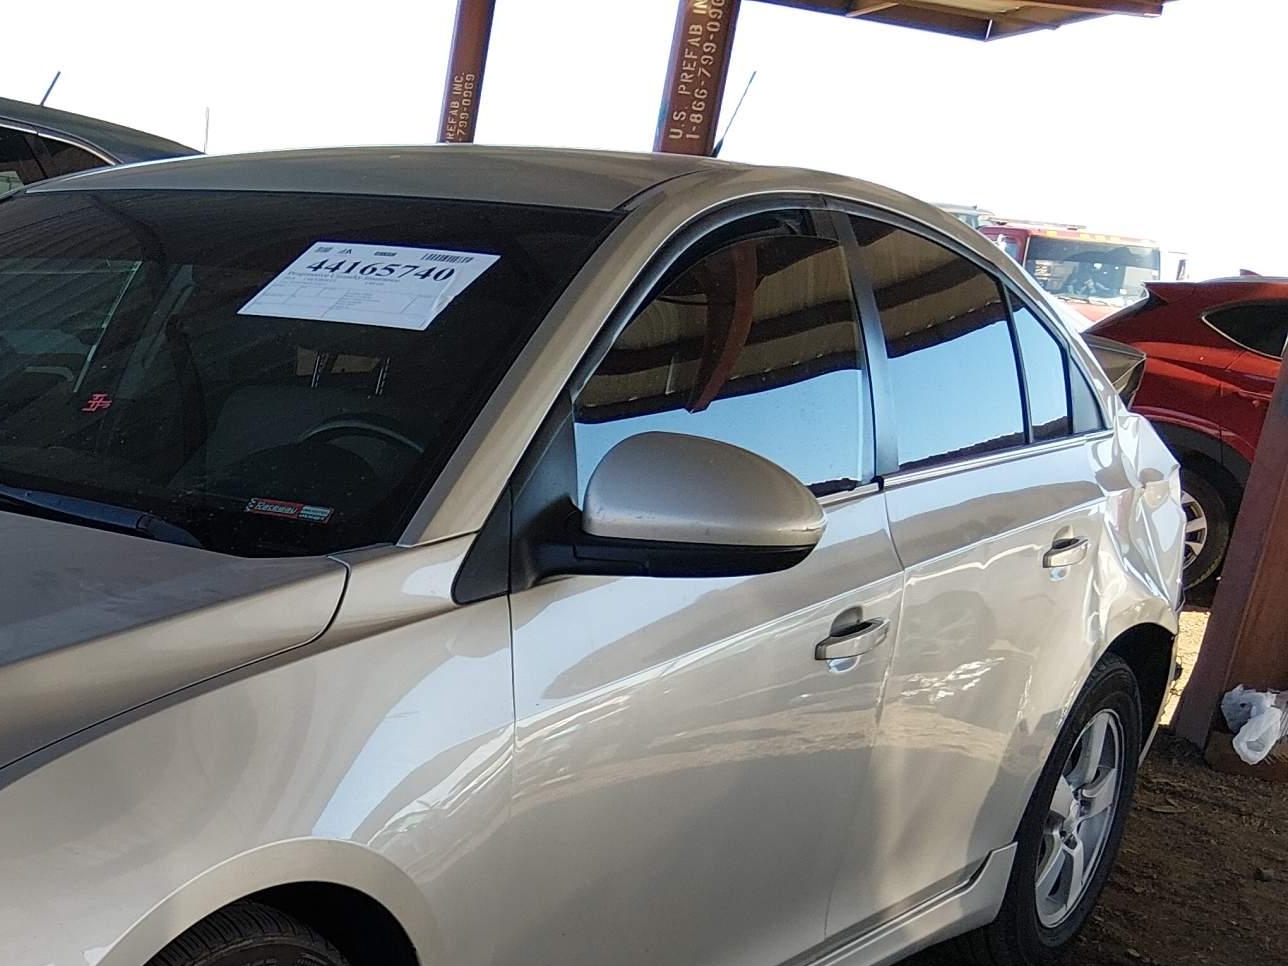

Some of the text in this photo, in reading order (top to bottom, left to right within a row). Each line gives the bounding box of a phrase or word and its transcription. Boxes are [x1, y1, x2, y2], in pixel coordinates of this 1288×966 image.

[678, 24, 703, 95] PREFAB
[452, 72, 465, 95] INC.
[669, 106, 688, 139] U.S.
[306, 259, 455, 281] 44165740
